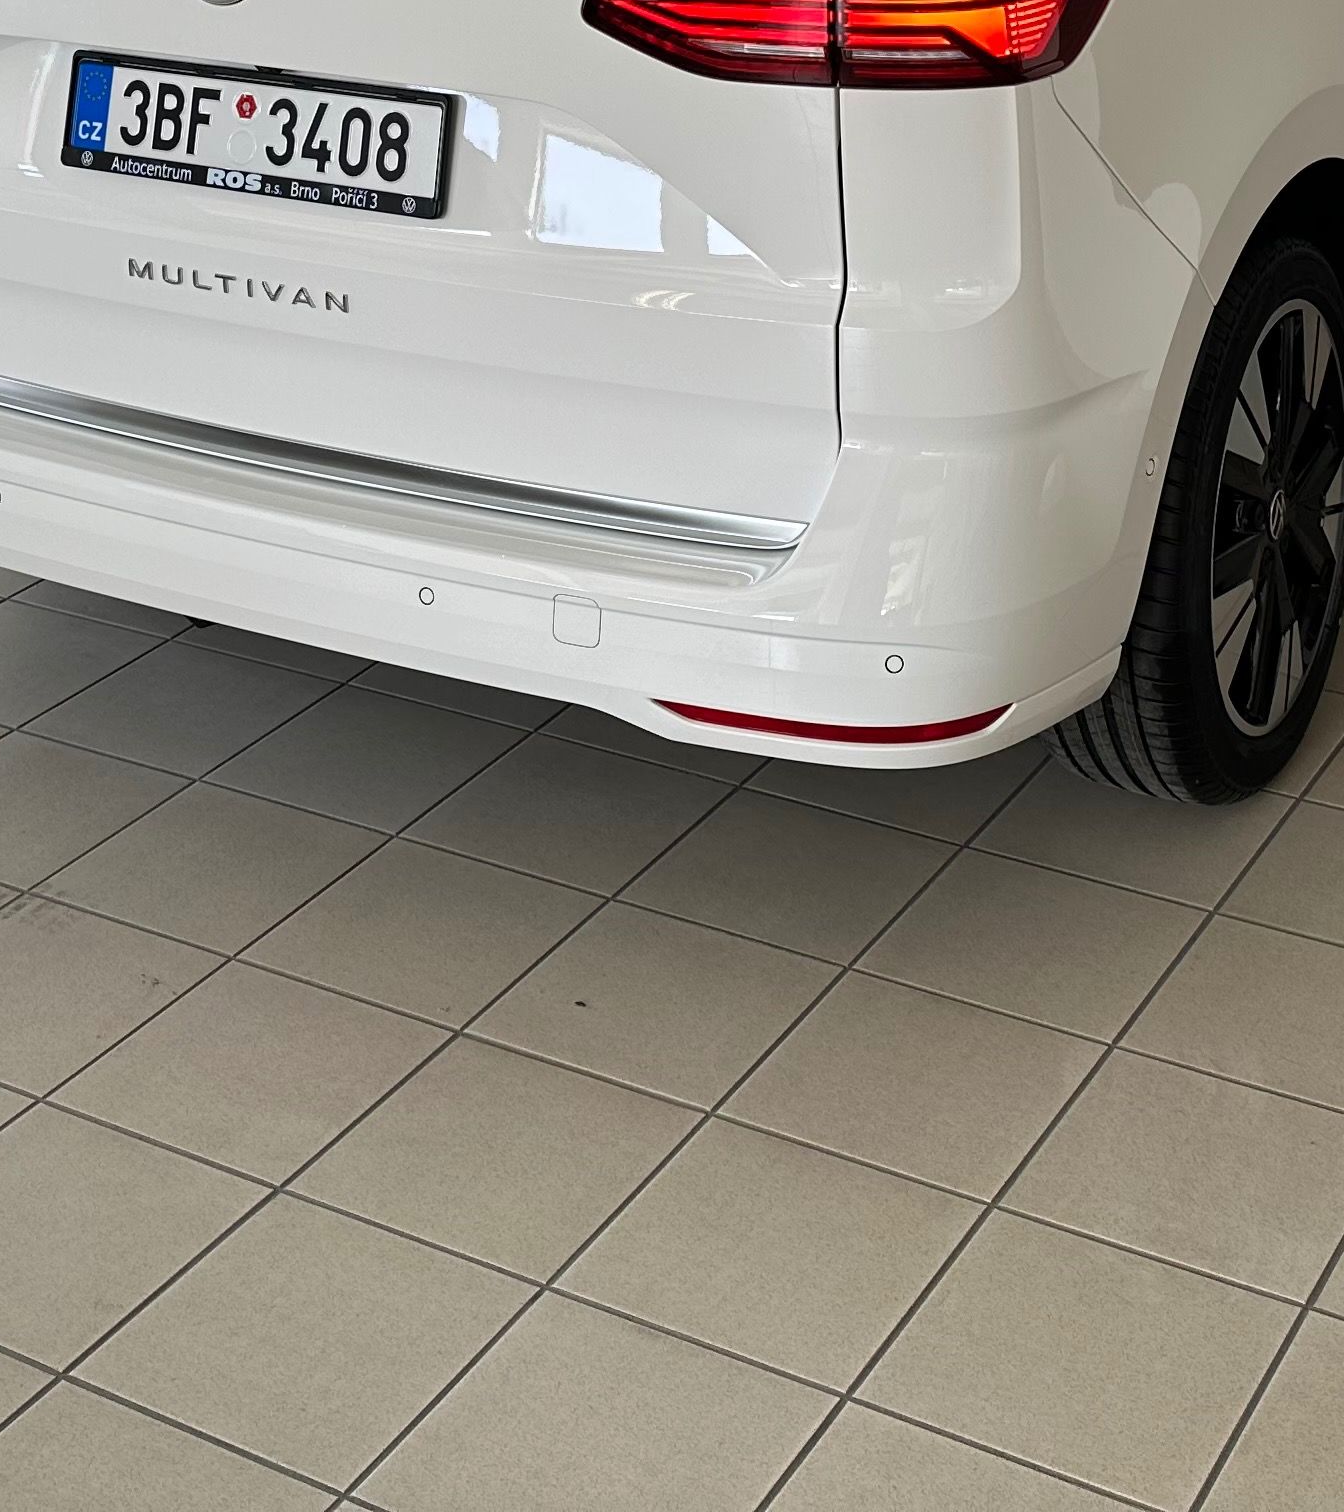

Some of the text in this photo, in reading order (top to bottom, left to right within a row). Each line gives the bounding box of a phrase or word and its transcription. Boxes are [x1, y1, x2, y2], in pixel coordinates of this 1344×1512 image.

[78, 120, 103, 141] CZ
[119, 79, 410, 182] 3BF 3408
[110, 156, 192, 182] Autocentrum
[206, 168, 262, 192] ROS
[264, 183, 282, 195] a.s.
[290, 181, 320, 201] Brno
[331, 187, 368, 208] Poříčí
[369, 193, 378, 209] 3
[128, 257, 351, 314] MULTIVAN
